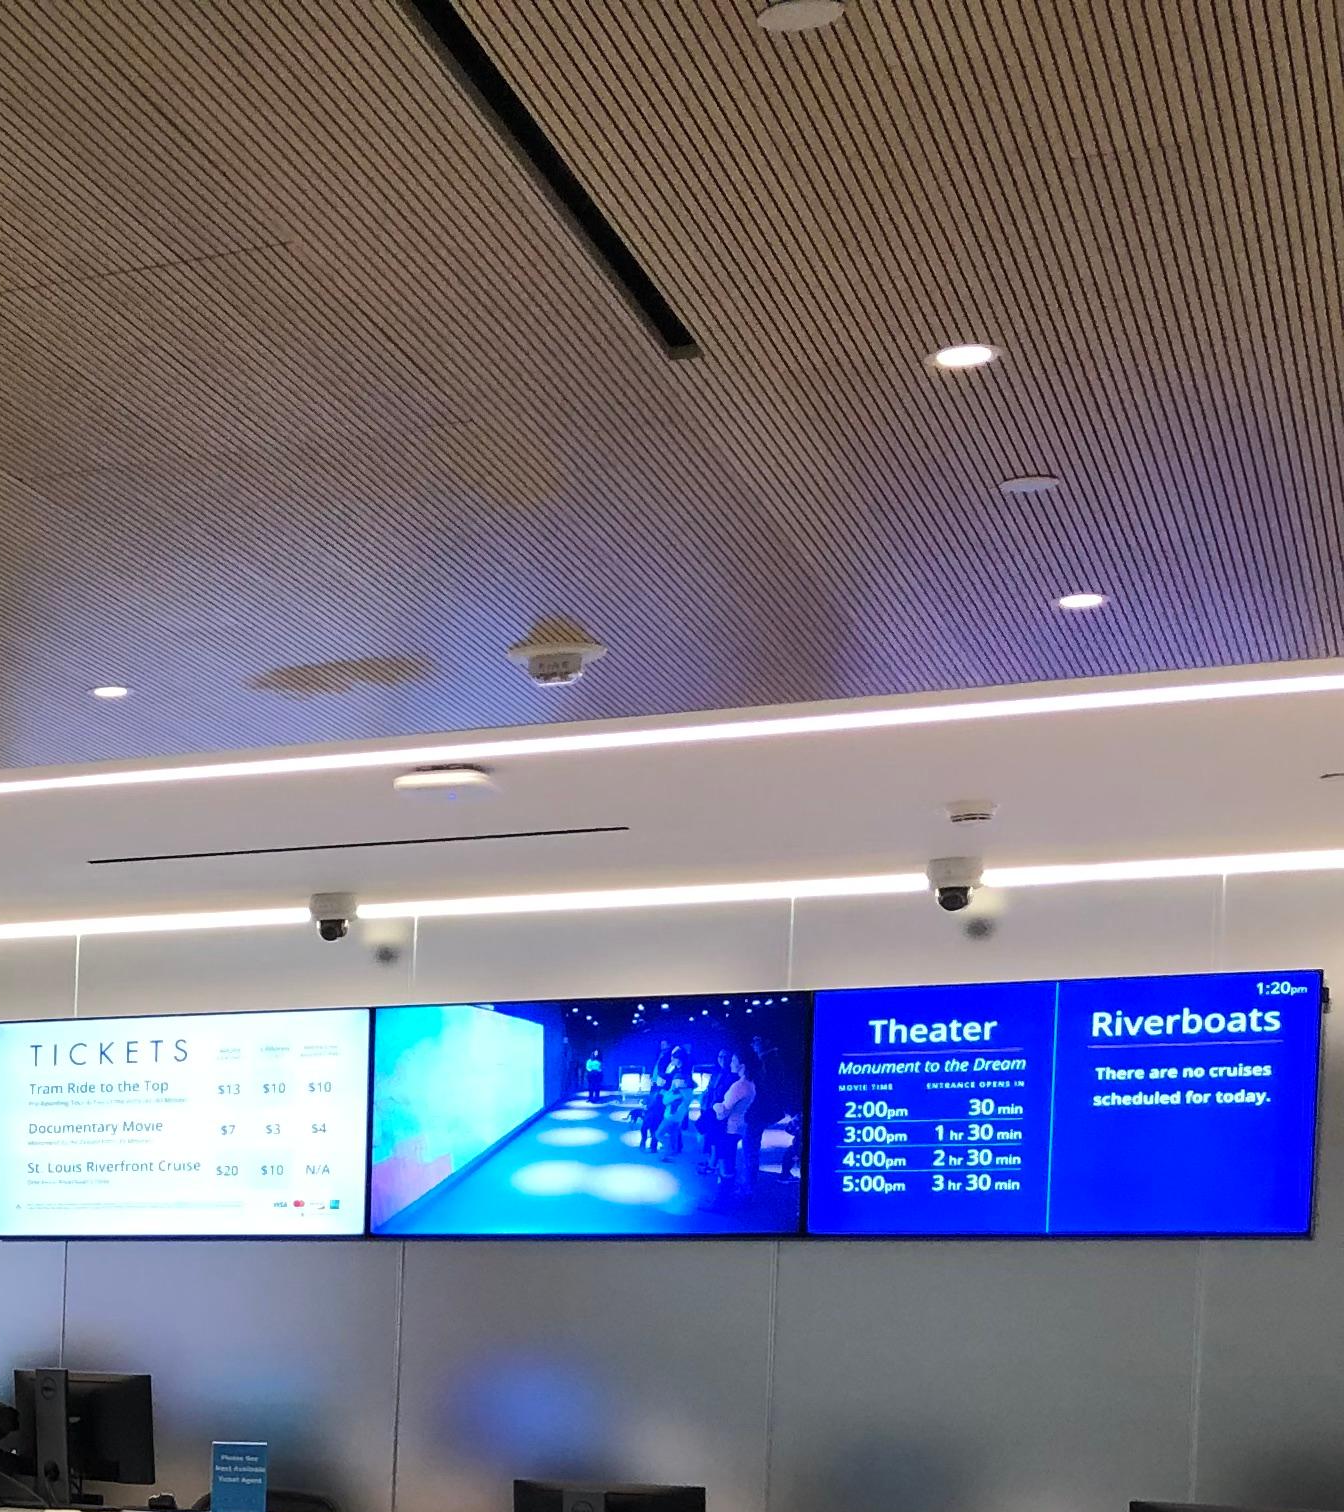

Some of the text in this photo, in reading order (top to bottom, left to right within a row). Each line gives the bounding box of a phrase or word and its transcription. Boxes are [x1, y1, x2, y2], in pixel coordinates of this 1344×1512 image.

[1256, 981, 1308, 996] 1:20pm
[1091, 1007, 1282, 1037] Riverboats
[868, 1018, 998, 1044] Theater
[29, 1039, 188, 1067] TICKETS
[838, 1057, 1026, 1075] Monument to the Dream
[1095, 1063, 1273, 1080] There are no cruises
[29, 1080, 169, 1095] Tram Ride to the Top
[218, 1084, 241, 1095] $13
[263, 1082, 286, 1094] $10
[308, 1081, 332, 1093] $10
[838, 1083, 893, 1092] MOVIE TIME
[926, 1080, 1025, 1090] ENTRANCE OPENS IN
[1092, 1089, 1271, 1107] scheduled for today.
[844, 1101, 909, 1119] 2:00pm
[968, 1098, 1024, 1116] 30 min
[28, 1120, 163, 1135] Documentary Movie
[221, 1124, 236, 1136] $7
[266, 1123, 281, 1135] $3
[843, 1126, 908, 1144] 3:00pm
[935, 1123, 1023, 1141] 1 hr 30 min
[842, 1151, 906, 1169] 4:00pm
[932, 1149, 1021, 1167] 2 hr 30 min
[48, 1162, 82, 1173] Louis
[86, 1161, 154, 1173] Riverfront
[158, 1160, 201, 1172] Cruise
[216, 1165, 238, 1176] $20
[261, 1164, 284, 1176] $10
[305, 1164, 330, 1175] N/A
[842, 1175, 906, 1194] 5:00pm
[932, 1174, 1020, 1192] 3 hr 30 min
